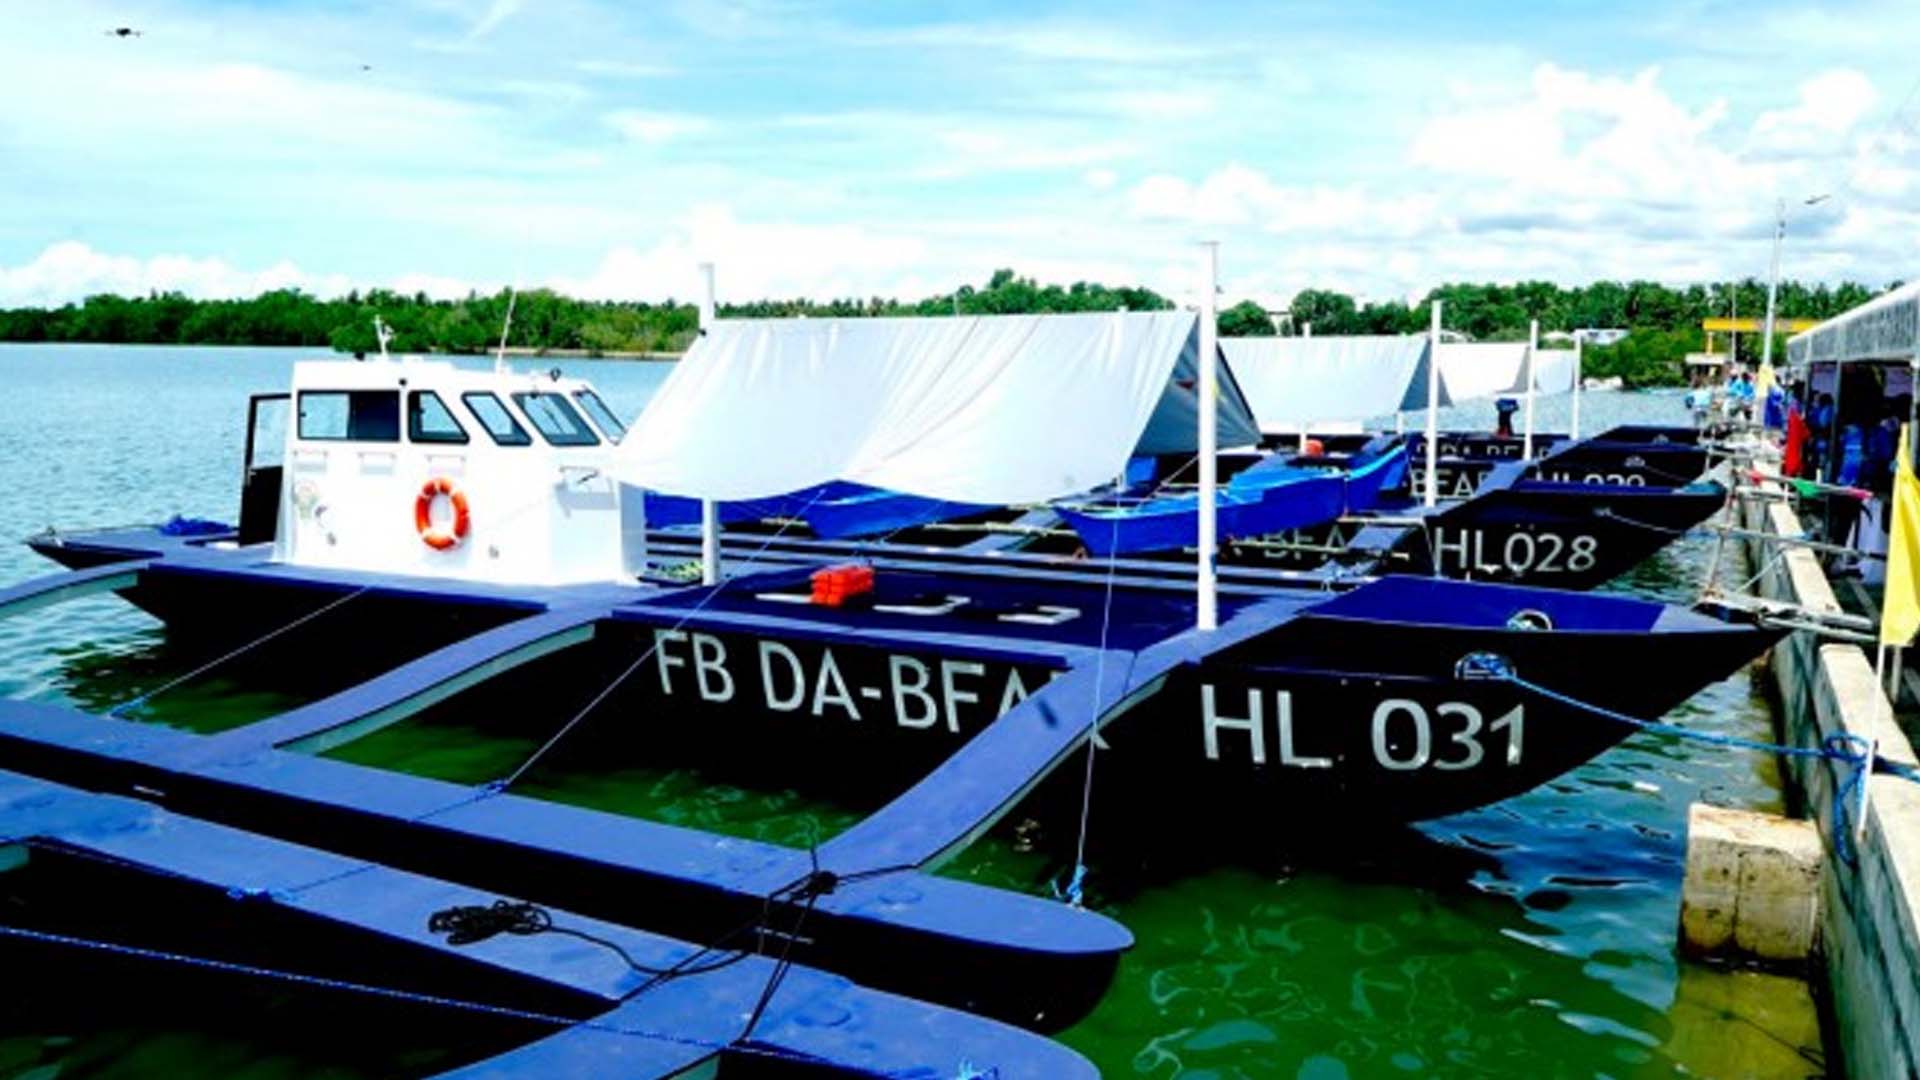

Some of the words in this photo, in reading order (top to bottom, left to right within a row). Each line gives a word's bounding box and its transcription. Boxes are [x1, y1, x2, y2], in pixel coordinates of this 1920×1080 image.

[653, 629, 735, 702] FB
[758, 640, 1110, 750] DA-BFA
[1201, 684, 1333, 768] HL
[1371, 699, 1525, 770] 031
